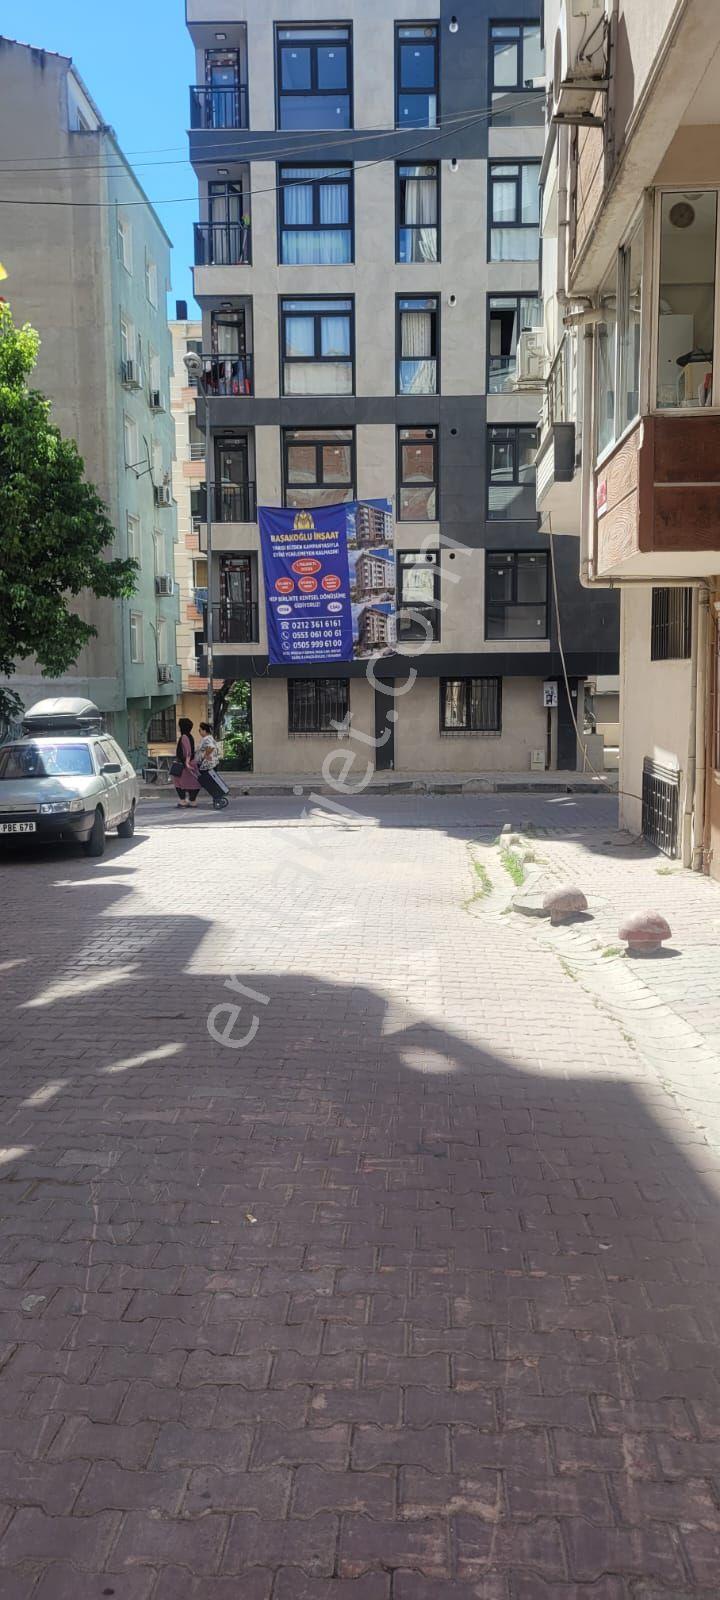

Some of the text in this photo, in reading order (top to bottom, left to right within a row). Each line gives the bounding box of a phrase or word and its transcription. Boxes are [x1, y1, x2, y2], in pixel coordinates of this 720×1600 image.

[313, 531, 339, 541] İNŞAAT
[291, 621, 309, 629] 0212
[311, 620, 323, 628] 361
[292, 631, 309, 639] 0553
[310, 630, 322, 638] 061
[334, 629, 342, 637] 61
[293, 641, 310, 649] 0505
[311, 640, 324, 648] 999
